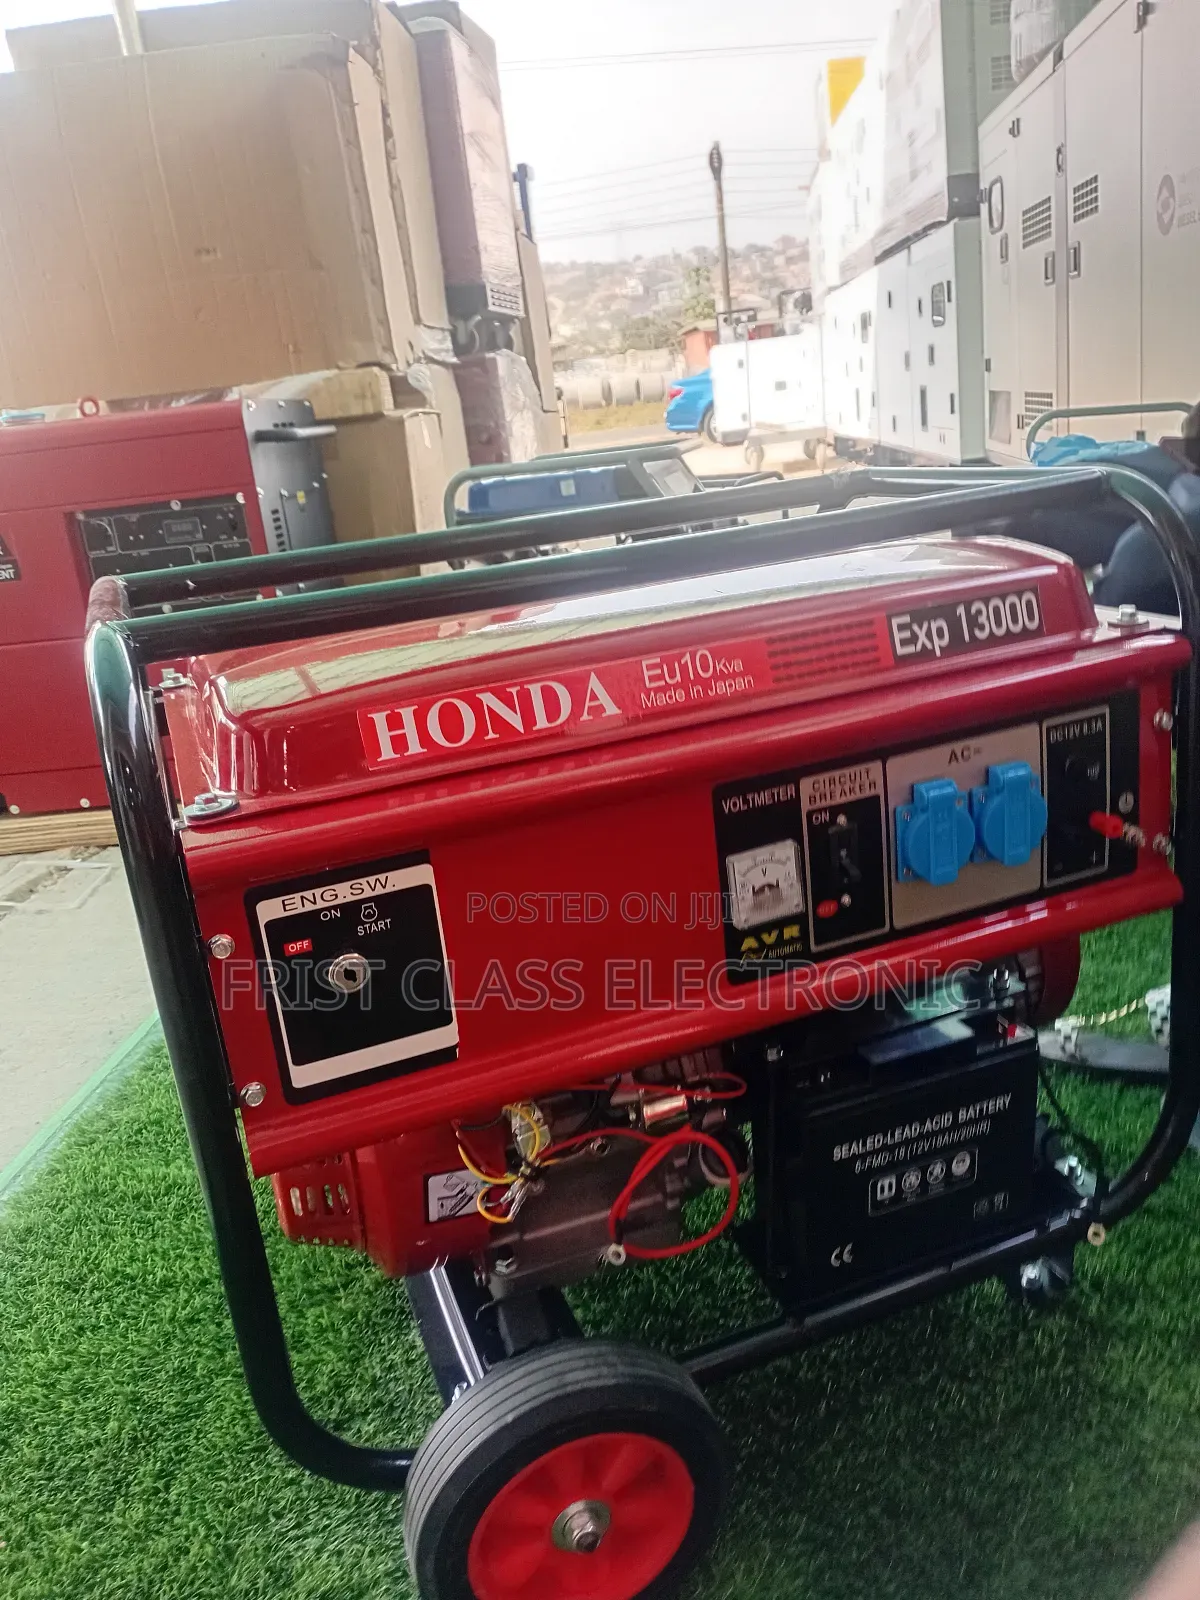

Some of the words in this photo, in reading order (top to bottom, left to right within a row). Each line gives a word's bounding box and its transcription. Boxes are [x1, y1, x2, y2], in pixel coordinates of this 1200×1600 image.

[891, 613, 950, 657] Exp
[956, 591, 1040, 643] 13000
[641, 686, 686, 709] Made
[708, 674, 755, 697] Japan
[367, 671, 622, 762] HONDA
[808, 780, 877, 806] BREAKER
[812, 768, 871, 793] CIRCUIT
[722, 783, 796, 815] VOLTMETER
[812, 810, 830, 826] ON
[281, 875, 396, 913] ENG.SW.
[320, 908, 341, 922] ON
[357, 918, 392, 936] START
[288, 940, 309, 953] OFF
[741, 924, 801, 952] AVR
[958, 1092, 1012, 1124] BATTERY
